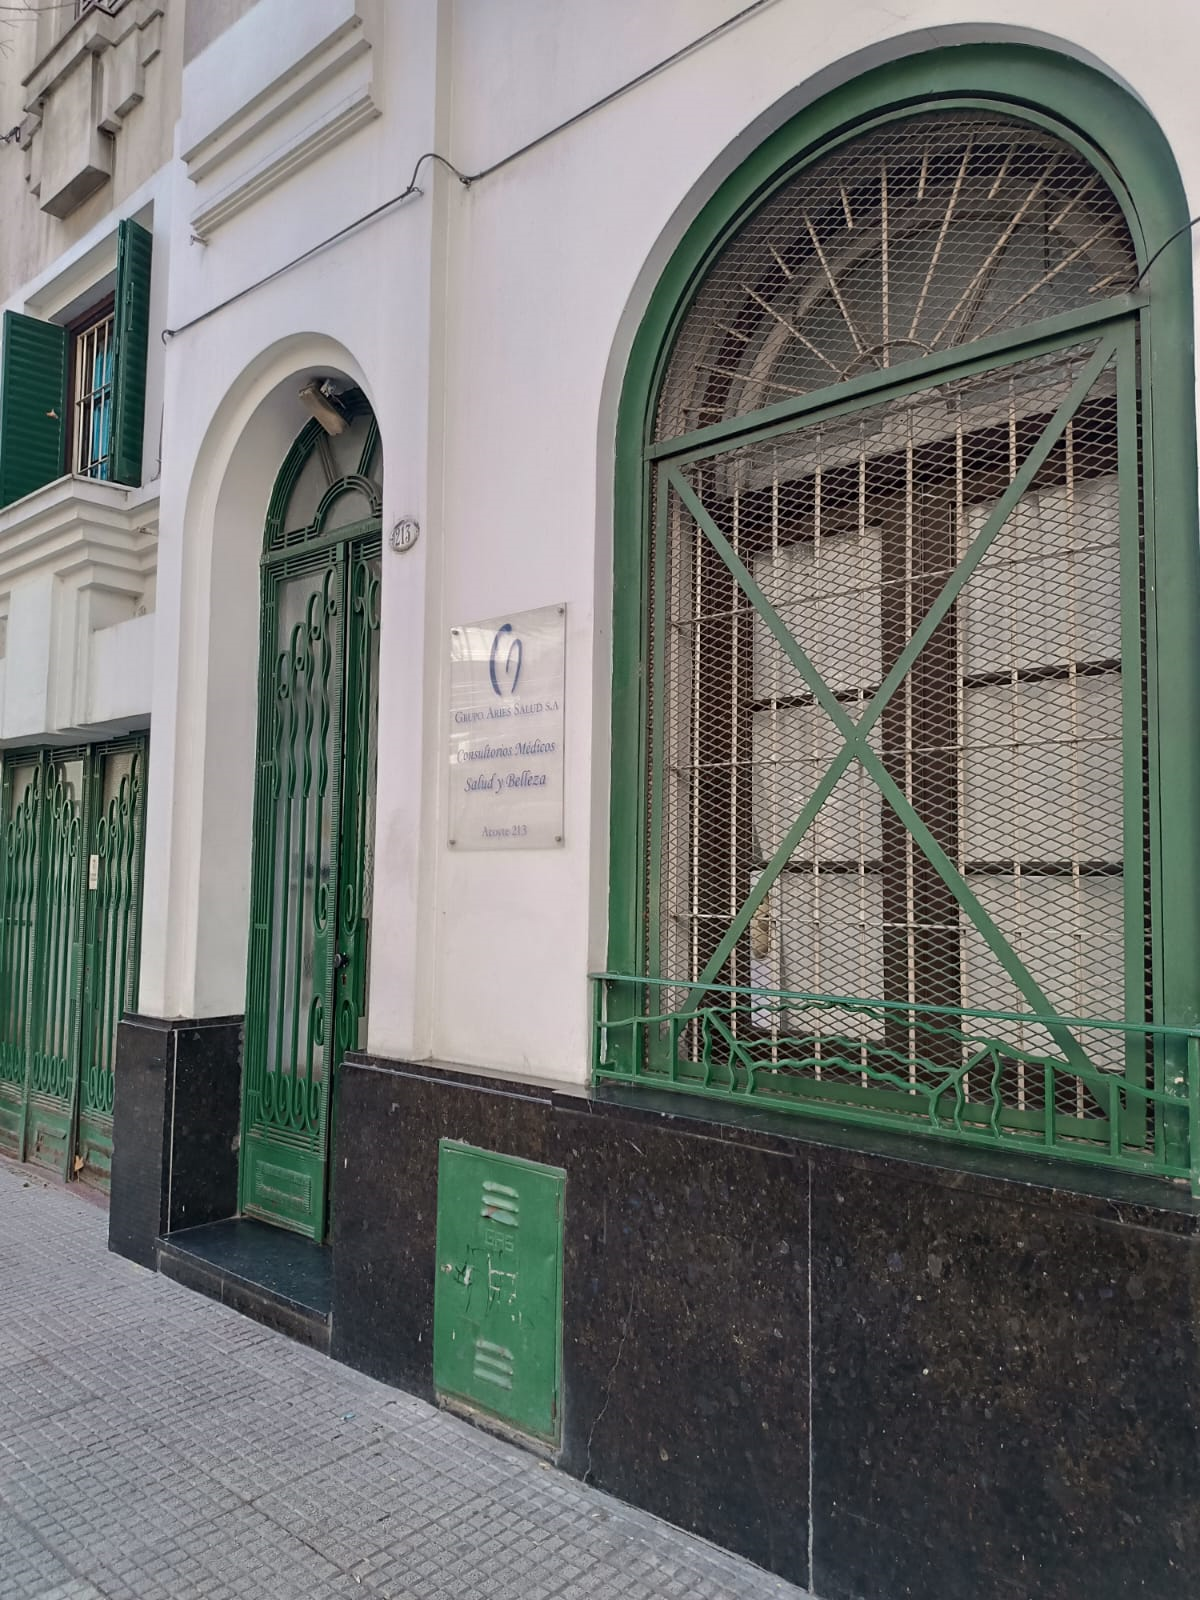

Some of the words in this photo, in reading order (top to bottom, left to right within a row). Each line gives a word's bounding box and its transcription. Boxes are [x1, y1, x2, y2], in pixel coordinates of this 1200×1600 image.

[395, 524, 411, 546] 213
[487, 706, 512, 720] ARIES
[514, 702, 543, 716] SALUD
[457, 744, 513, 764] Consultorios
[515, 738, 556, 756] Médicos
[464, 773, 496, 792] Salud
[495, 777, 504, 794] y
[506, 769, 547, 788] Belleza
[511, 824, 528, 836] 213
